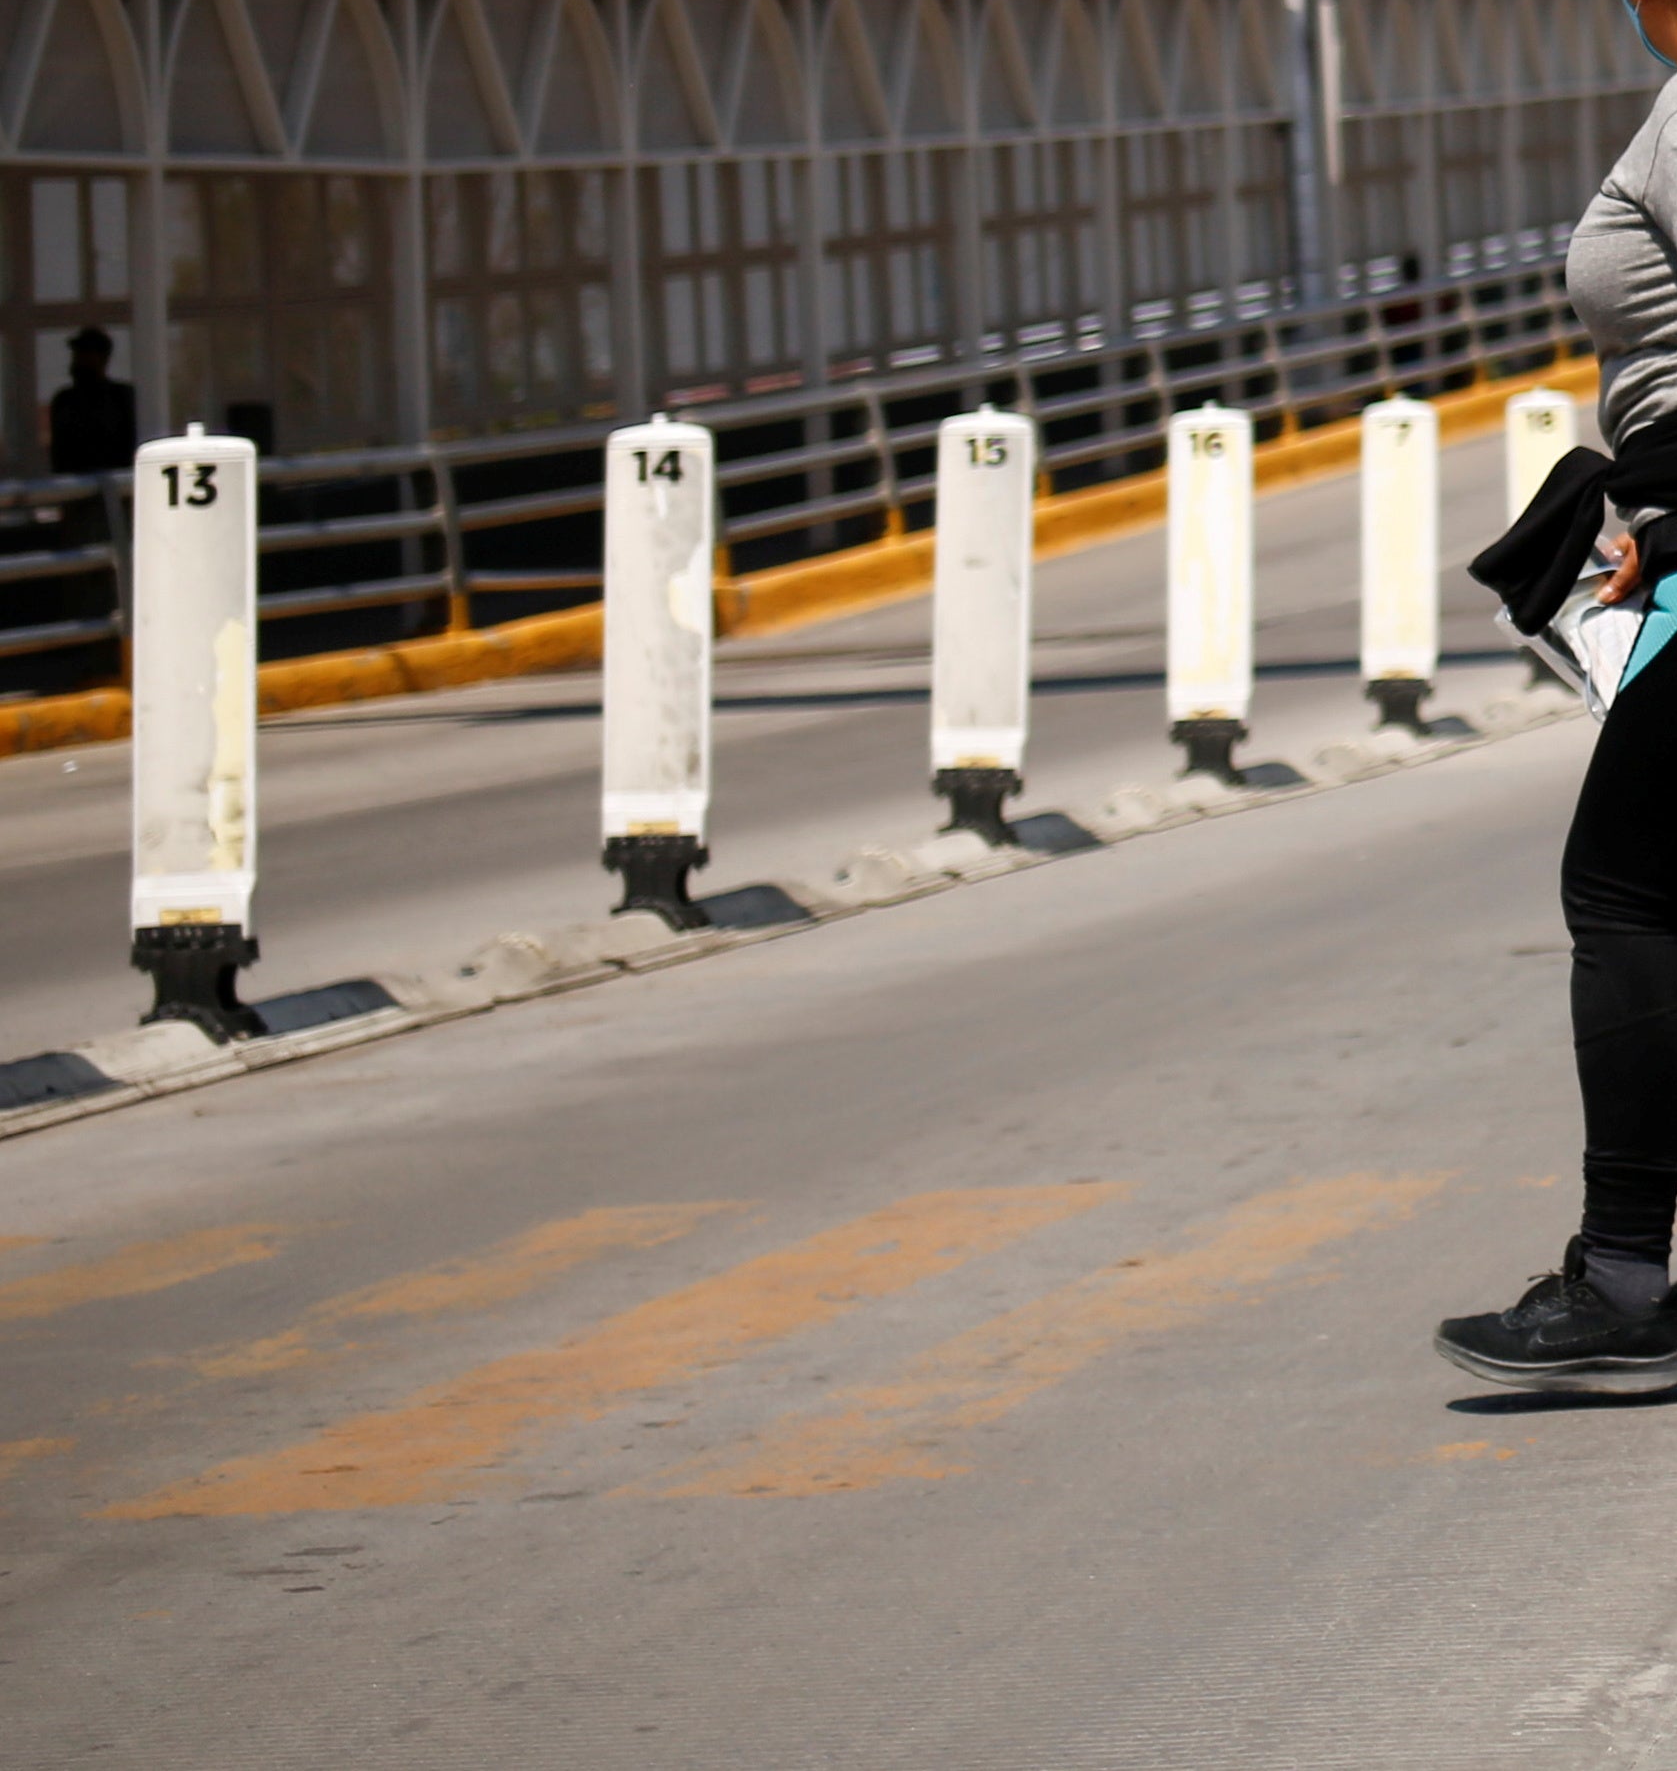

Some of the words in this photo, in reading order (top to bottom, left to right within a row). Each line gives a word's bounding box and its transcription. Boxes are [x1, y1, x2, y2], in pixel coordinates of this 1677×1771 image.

[966, 437, 1007, 466] 15
[1189, 431, 1225, 461] 16
[632, 450, 684, 483] 14
[161, 464, 218, 507] 13
